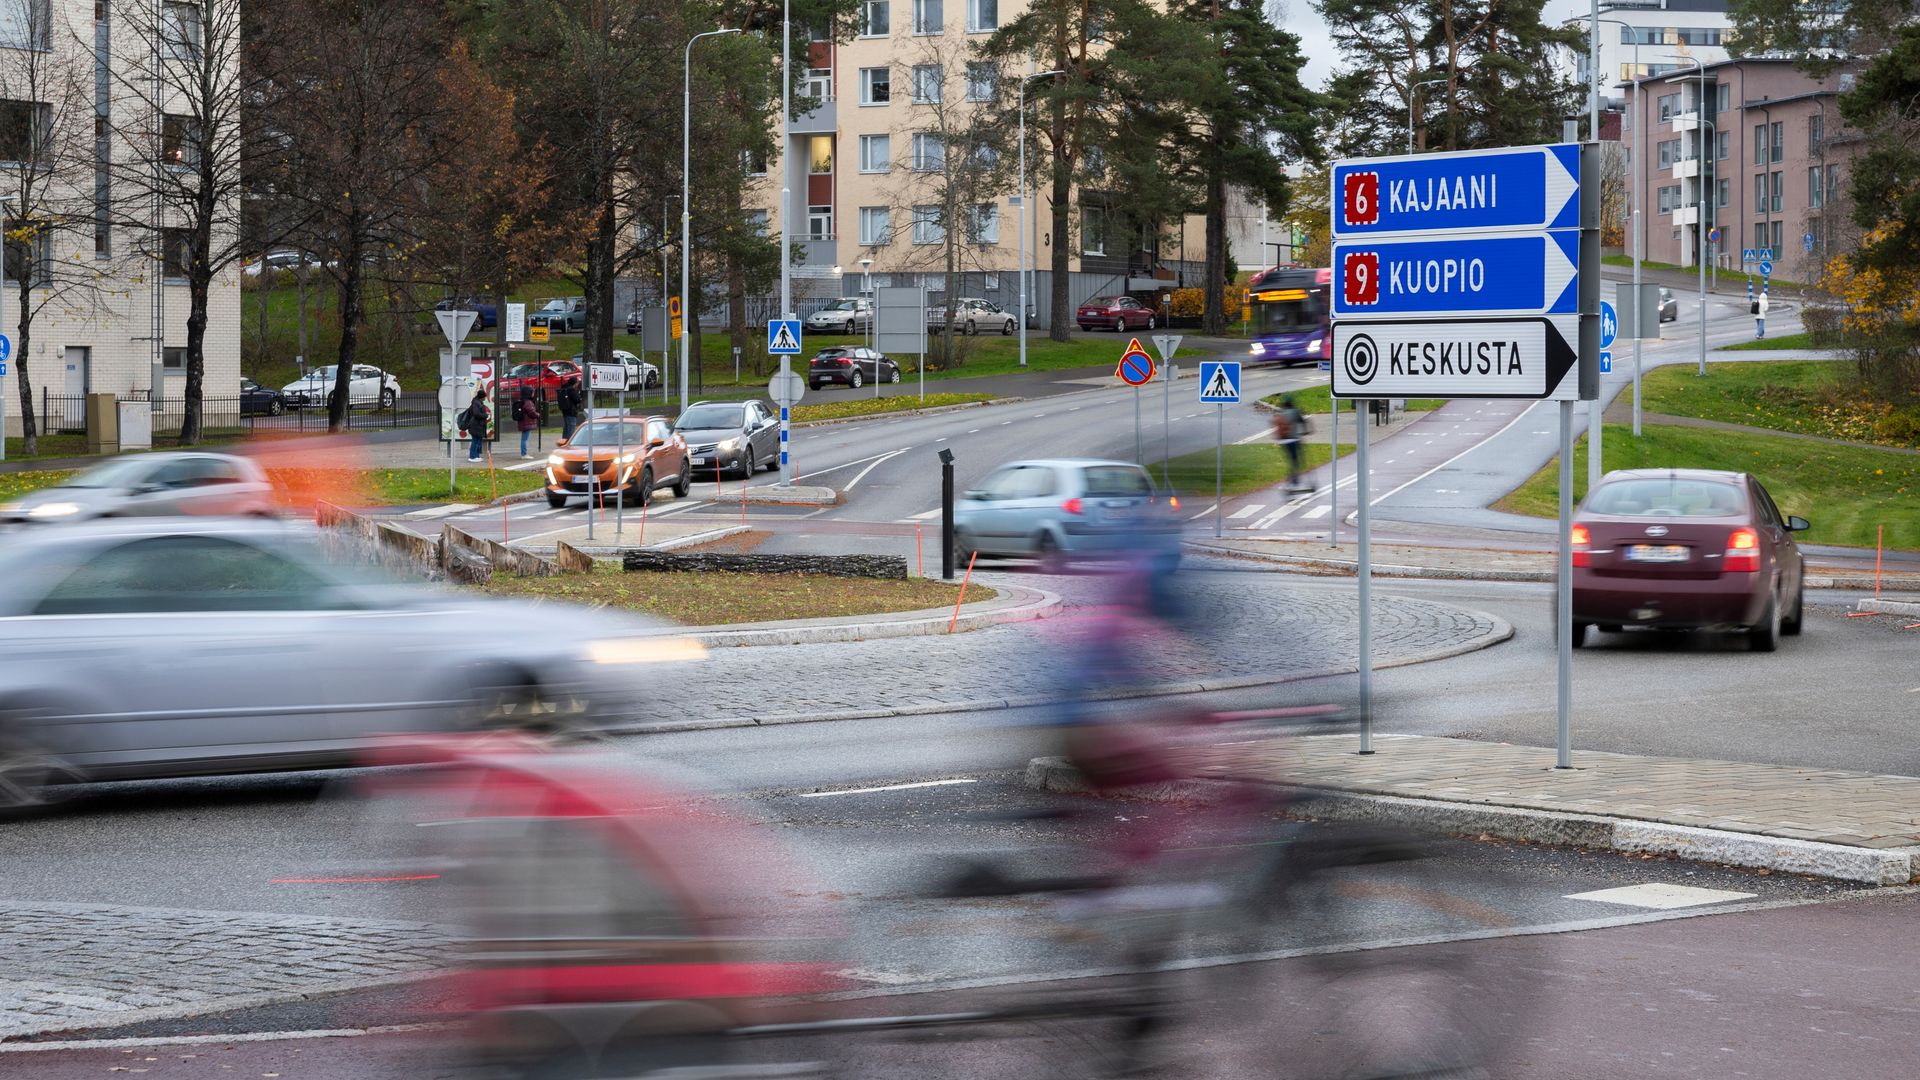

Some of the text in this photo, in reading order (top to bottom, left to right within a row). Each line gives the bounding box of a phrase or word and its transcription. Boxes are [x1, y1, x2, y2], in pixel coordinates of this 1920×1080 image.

[1355, 174, 1496, 215] 6 KAJAANI
[1044, 232, 1050, 246] 3
[1355, 258, 1484, 295] 9 KUOPIO
[1390, 341, 1523, 376] KESKUSTA
